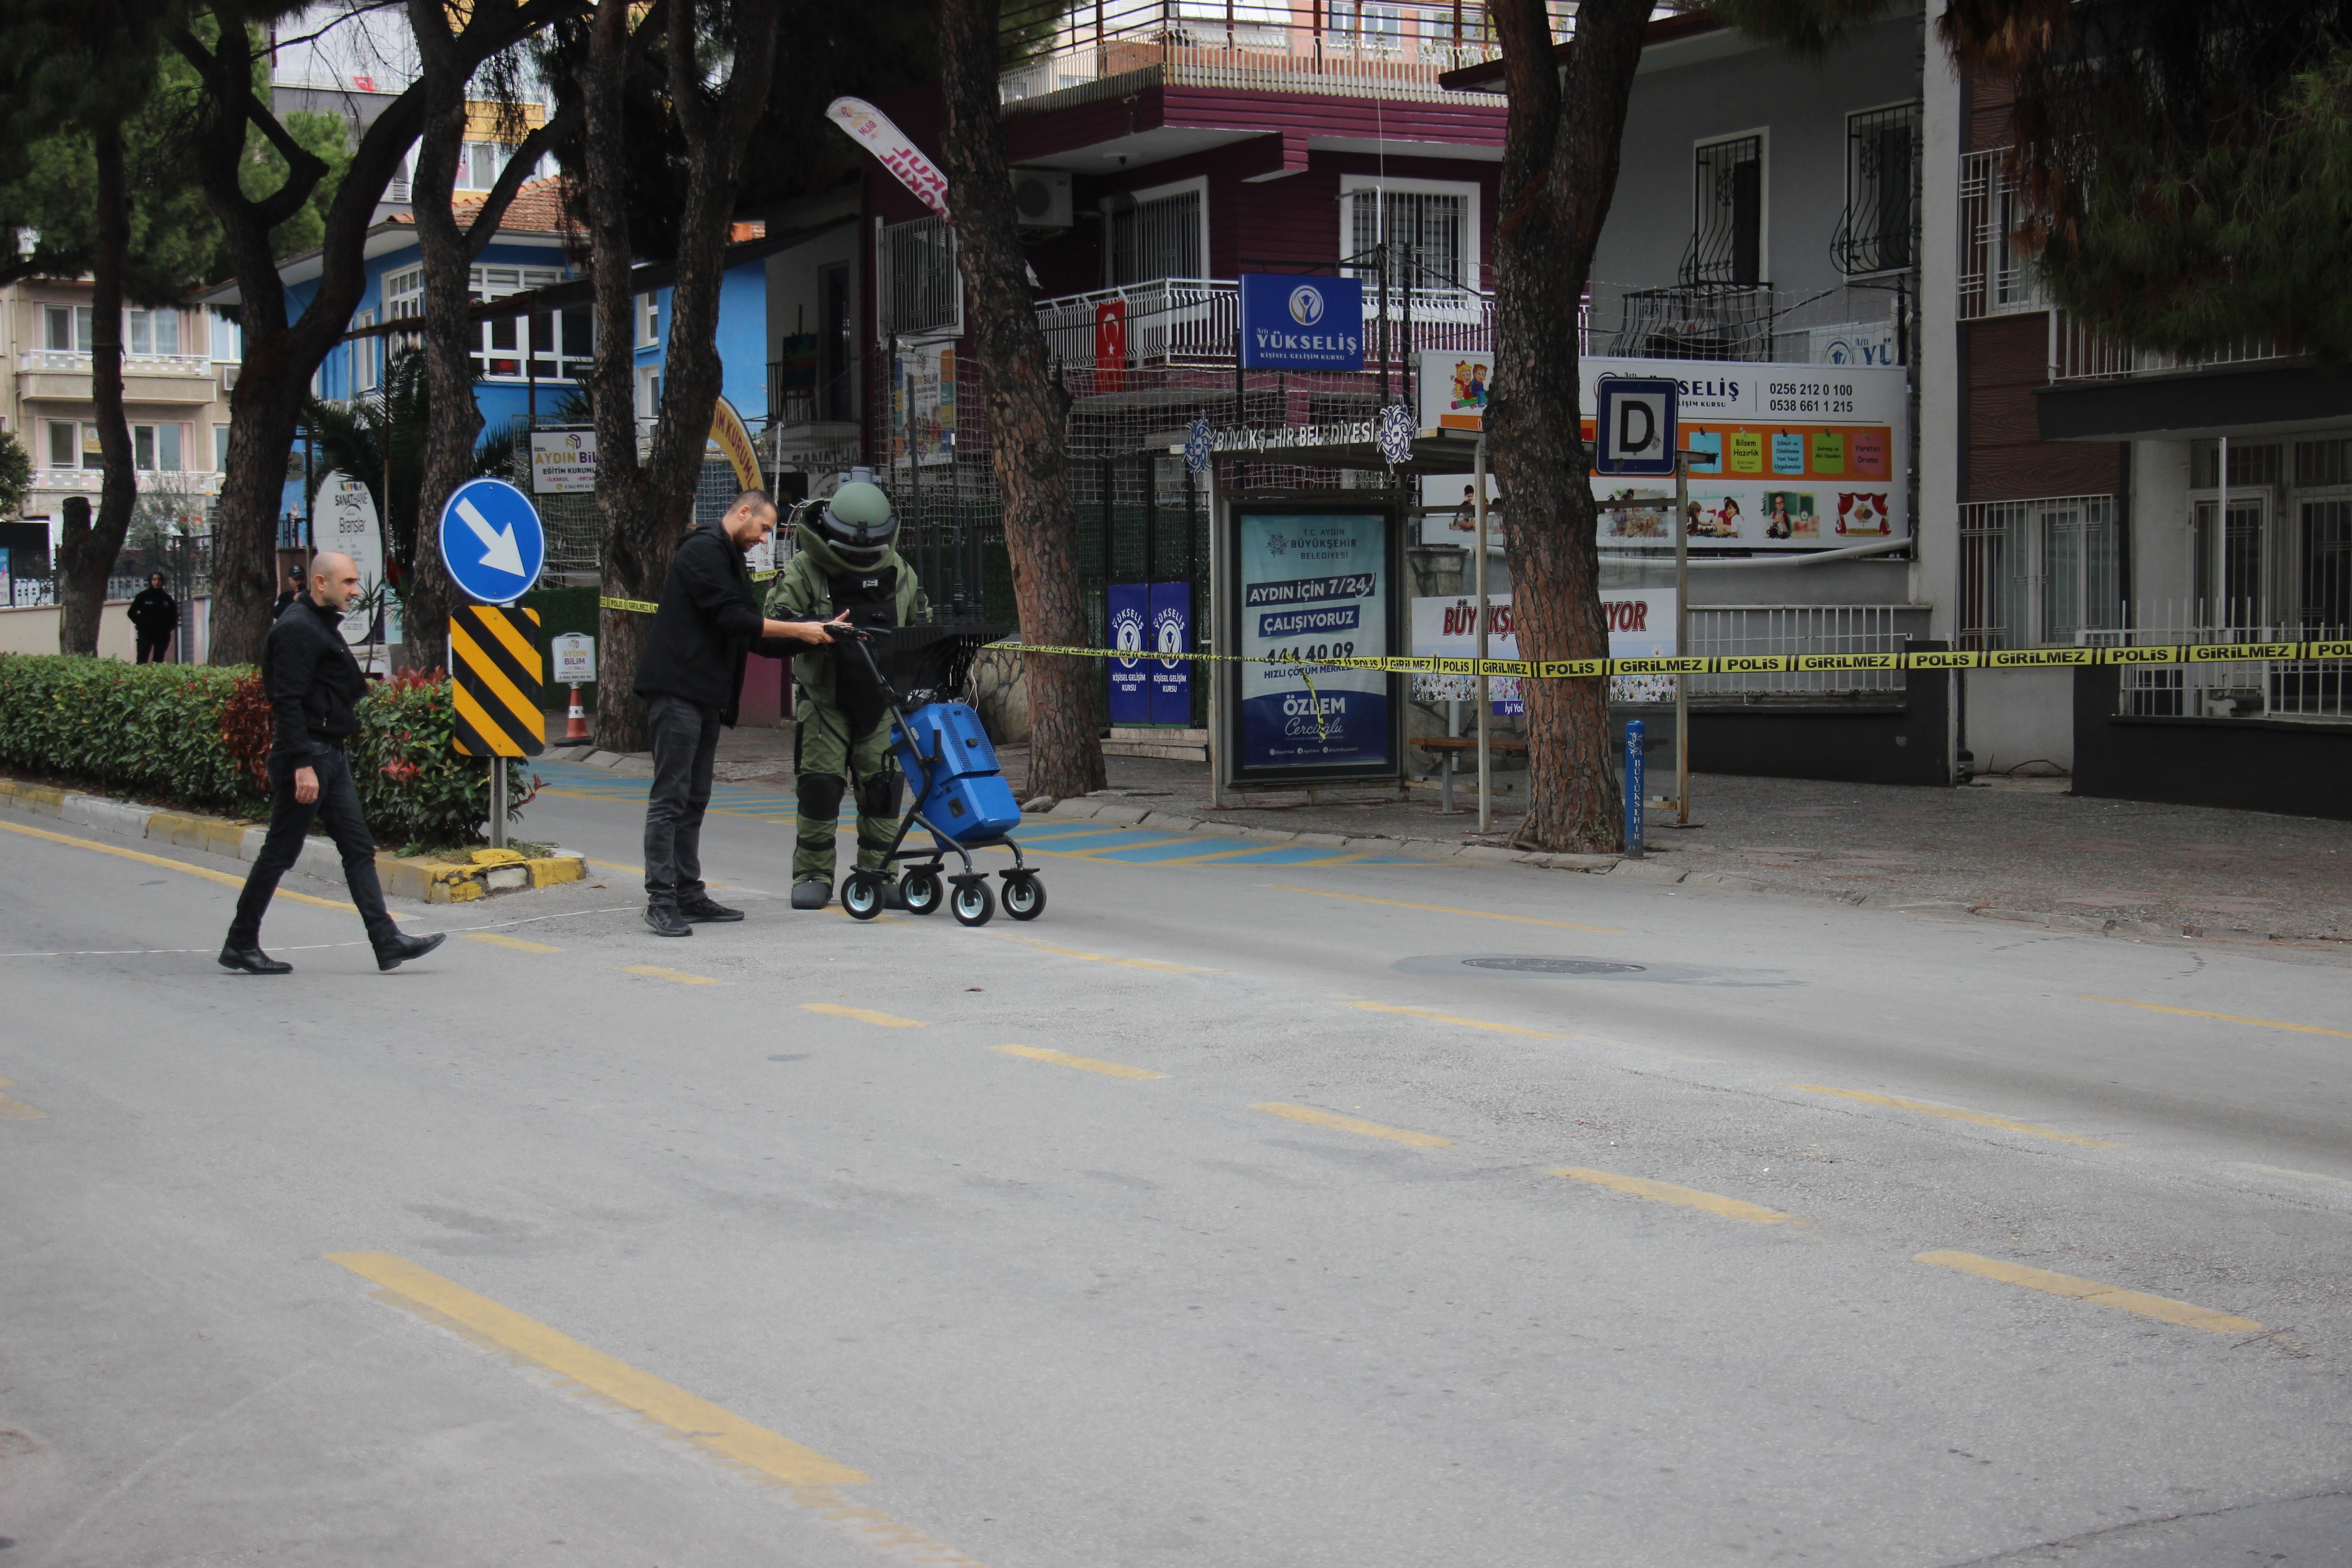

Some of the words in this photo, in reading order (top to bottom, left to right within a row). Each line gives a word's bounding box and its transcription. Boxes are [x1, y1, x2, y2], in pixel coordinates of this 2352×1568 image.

[1257, 331, 1357, 355] YÜKSELİŞ
[1770, 383, 1796, 395] 0256
[1800, 384, 1819, 395] 212
[1823, 384, 1829, 395] 0
[1833, 384, 1852, 396] 100
[1770, 400, 1797, 412] 0538
[1800, 400, 1818, 412] 661
[1823, 401, 1828, 412] 1
[1833, 401, 1853, 412] 215
[1299, 417, 1376, 447] BELEDİYESİ
[1619, 401, 1655, 452] D
[535, 451, 576, 464] AYDIN
[335, 493, 368, 506] SANATHANE
[340, 516, 366, 534] Branşlar
[1291, 537, 1357, 550] BÜYÜKŞEHİR
[1301, 550, 1348, 559] BELEDİYESİ
[1250, 586, 1294, 603] AYDIN
[1297, 580, 1324, 601] İÇİN
[1329, 577, 1367, 595] 7/24
[1264, 611, 1354, 635] ÇALIŞIYORUZ
[1305, 644, 1328, 661] 40
[1333, 642, 1354, 658] 09
[1112, 672, 1128, 683] KİŞİSEL
[1128, 672, 1146, 683] GELİŞİM
[1153, 673, 1169, 684] KİŞİSEL
[1169, 673, 1186, 684] GELİŞİM
[1264, 669, 1286, 679] HIZLI
[1283, 695, 1346, 715] ÖZLEM
[1504, 703, 1513, 715] İyi
